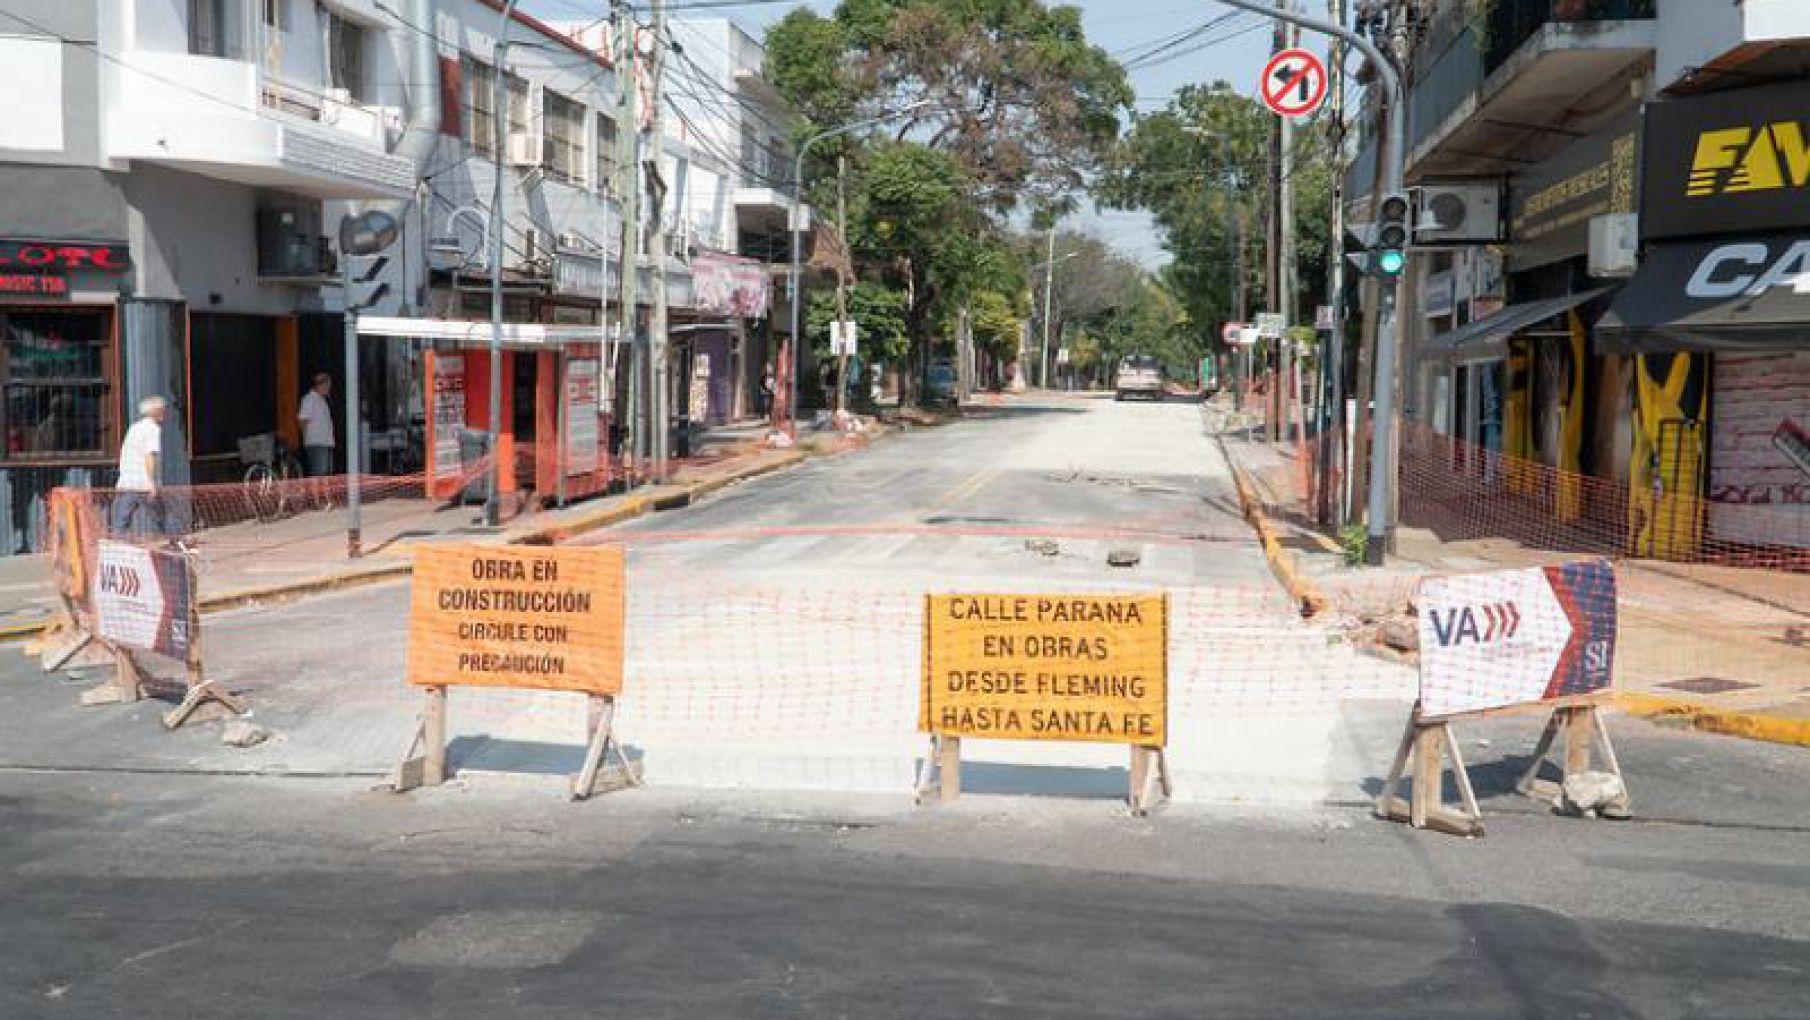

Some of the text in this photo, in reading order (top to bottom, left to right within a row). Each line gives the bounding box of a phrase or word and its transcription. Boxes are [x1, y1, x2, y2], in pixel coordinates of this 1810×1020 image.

[472, 559, 558, 581] OBRA EN
[438, 587, 592, 613] CONSTRUCCIÓN
[949, 597, 1142, 623] CALLE PARANA
[458, 622, 567, 643] CIRCULE CON
[1429, 606, 1481, 647] VA
[983, 635, 1108, 661] EN OBRAS
[458, 652, 565, 674] PRECAUCIÓN
[948, 670, 1146, 699] DESDE FLEMING
[941, 706, 1153, 737] HASTA SANTA FE
